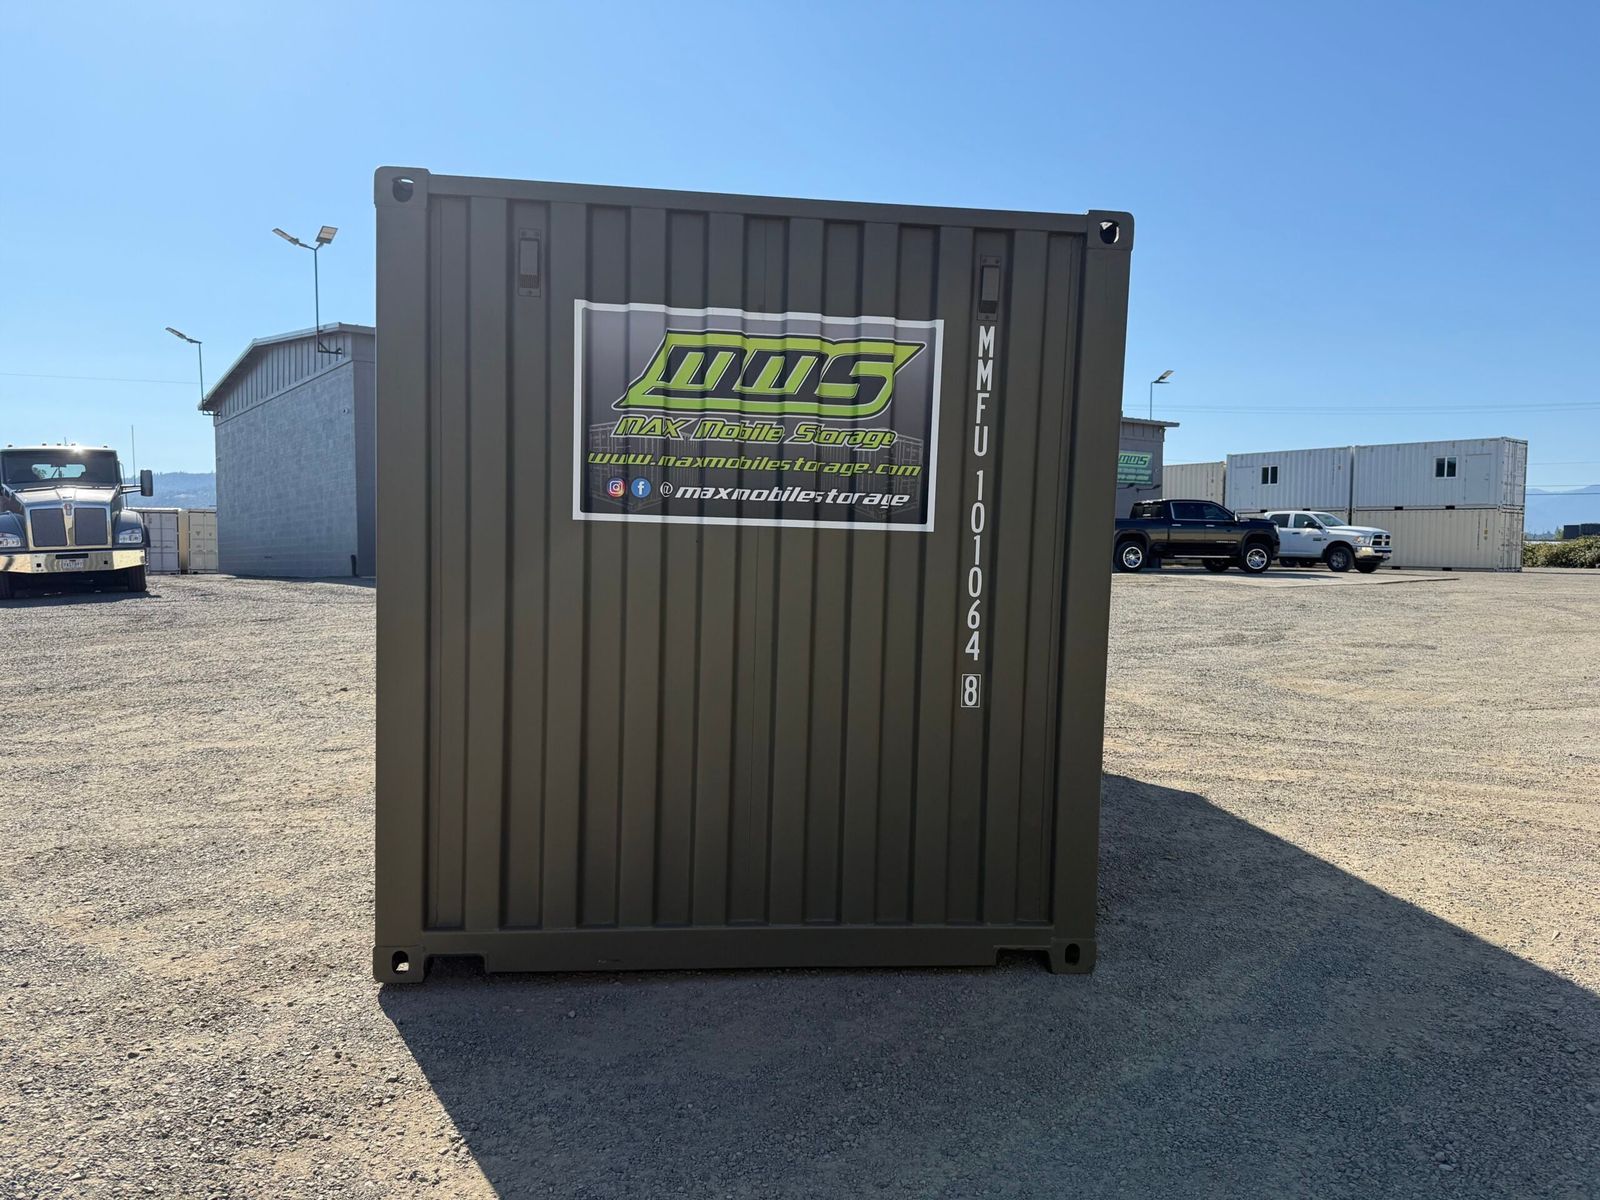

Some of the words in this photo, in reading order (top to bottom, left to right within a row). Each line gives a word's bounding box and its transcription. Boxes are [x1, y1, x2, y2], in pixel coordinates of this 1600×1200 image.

[972, 325, 996, 457] MMFU
[613, 415, 690, 439] MAX
[692, 418, 785, 442] Mobile
[787, 422, 897, 450] Storage
[587, 452, 922, 477] www.maxmobilestorage.com
[964, 469, 986, 661] 101064
[962, 674, 980, 706] 8
